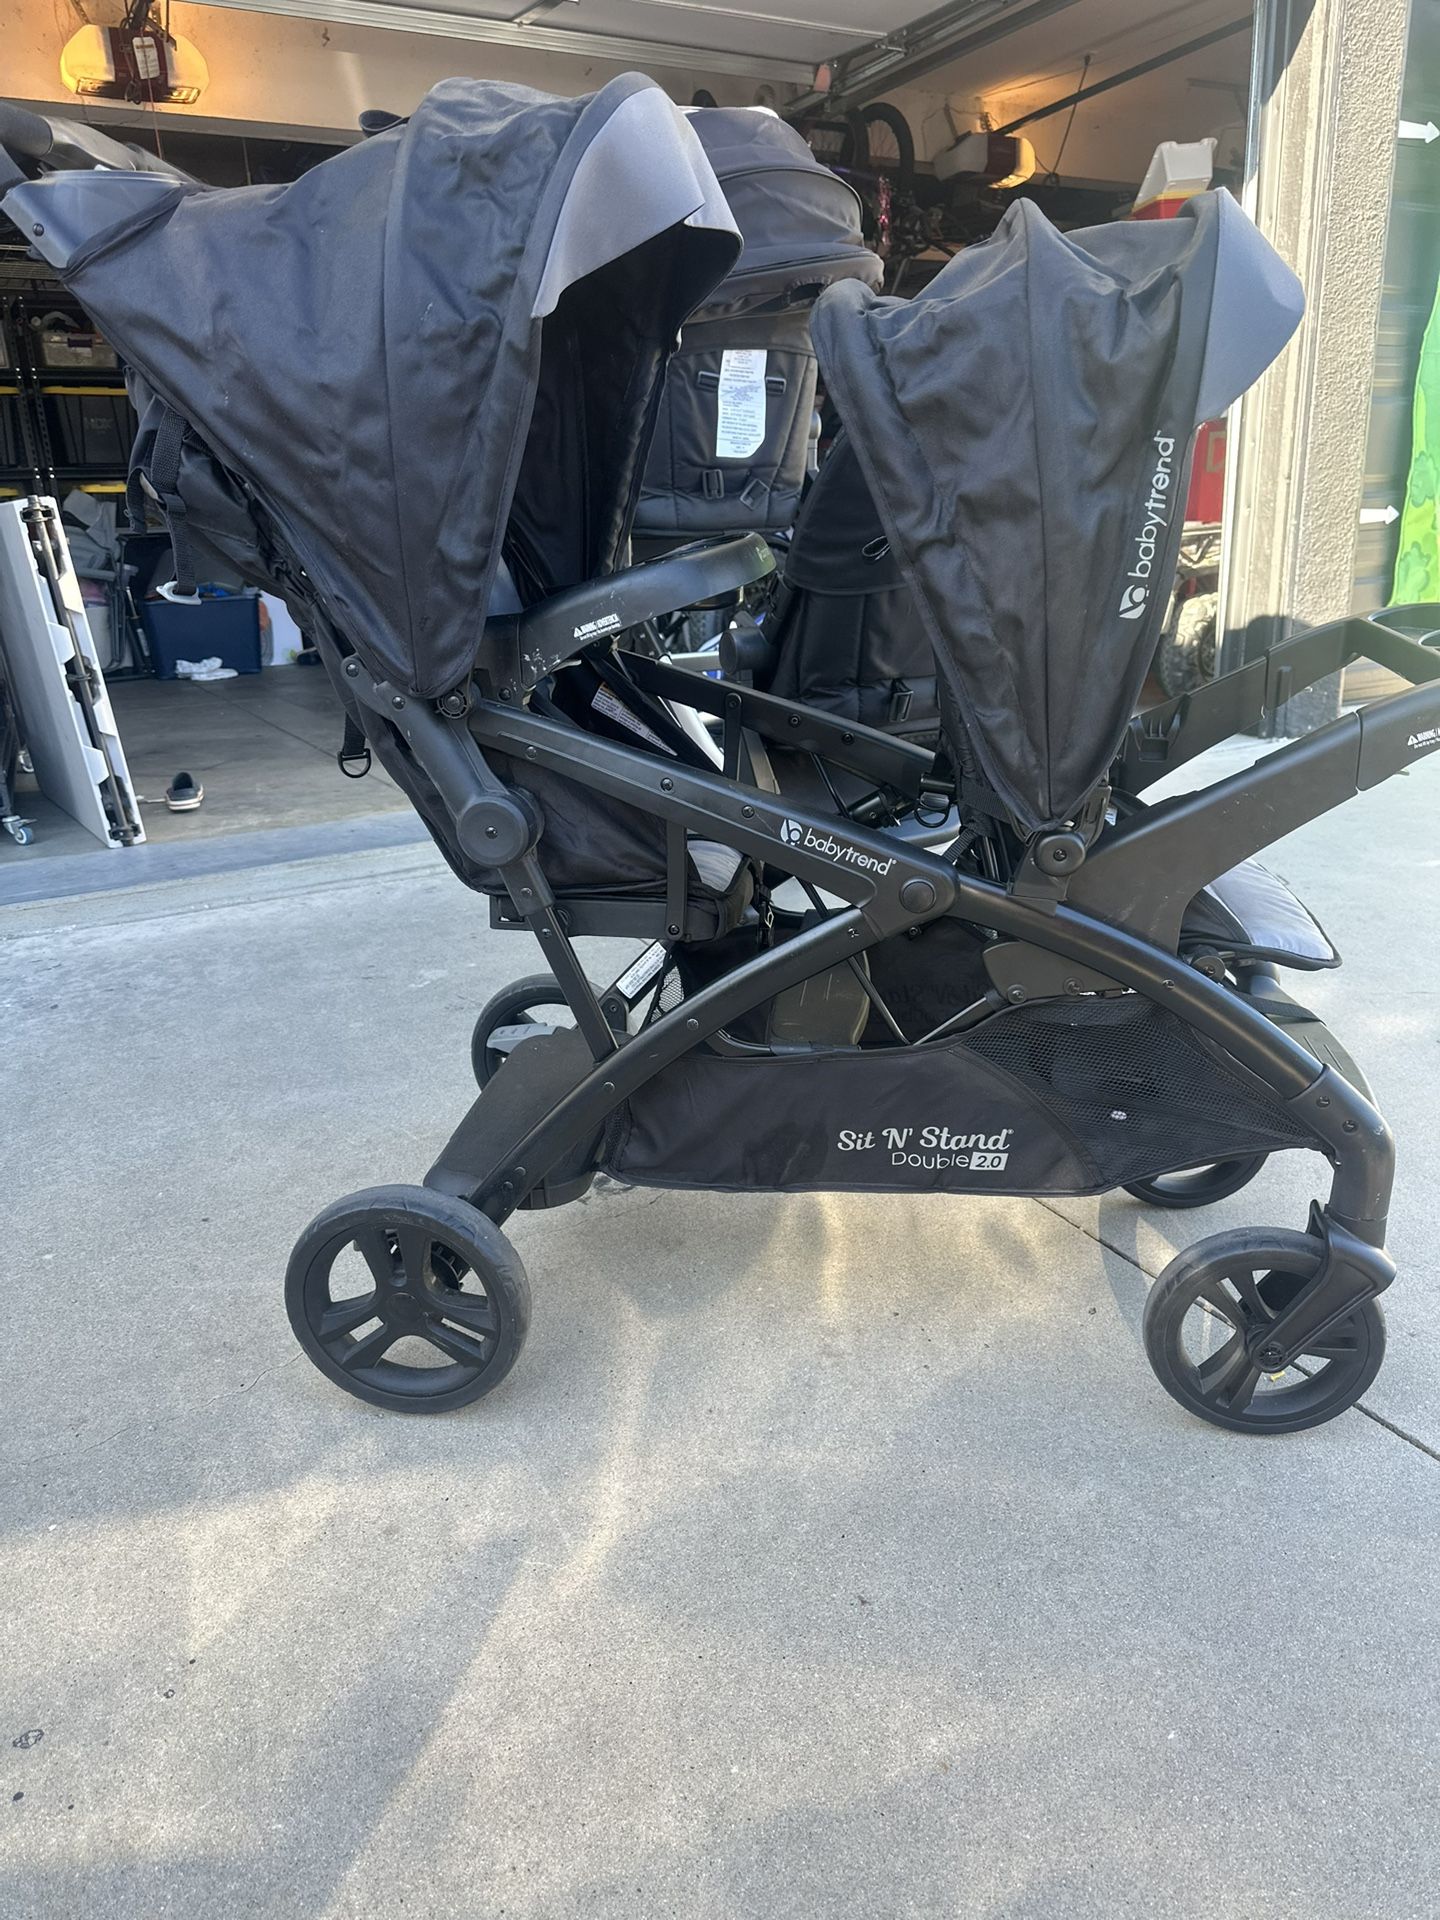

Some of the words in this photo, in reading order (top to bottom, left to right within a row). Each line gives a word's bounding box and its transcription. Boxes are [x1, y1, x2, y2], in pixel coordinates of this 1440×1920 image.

[1127, 437, 1176, 578] babytrend
[803, 827, 893, 876] babytrend
[837, 1130, 876, 1151] Sit
[881, 1127, 914, 1150] N'
[919, 1126, 1010, 1151] Stand
[891, 1151, 970, 1170] Double
[973, 1154, 1003, 1169] 2.0
